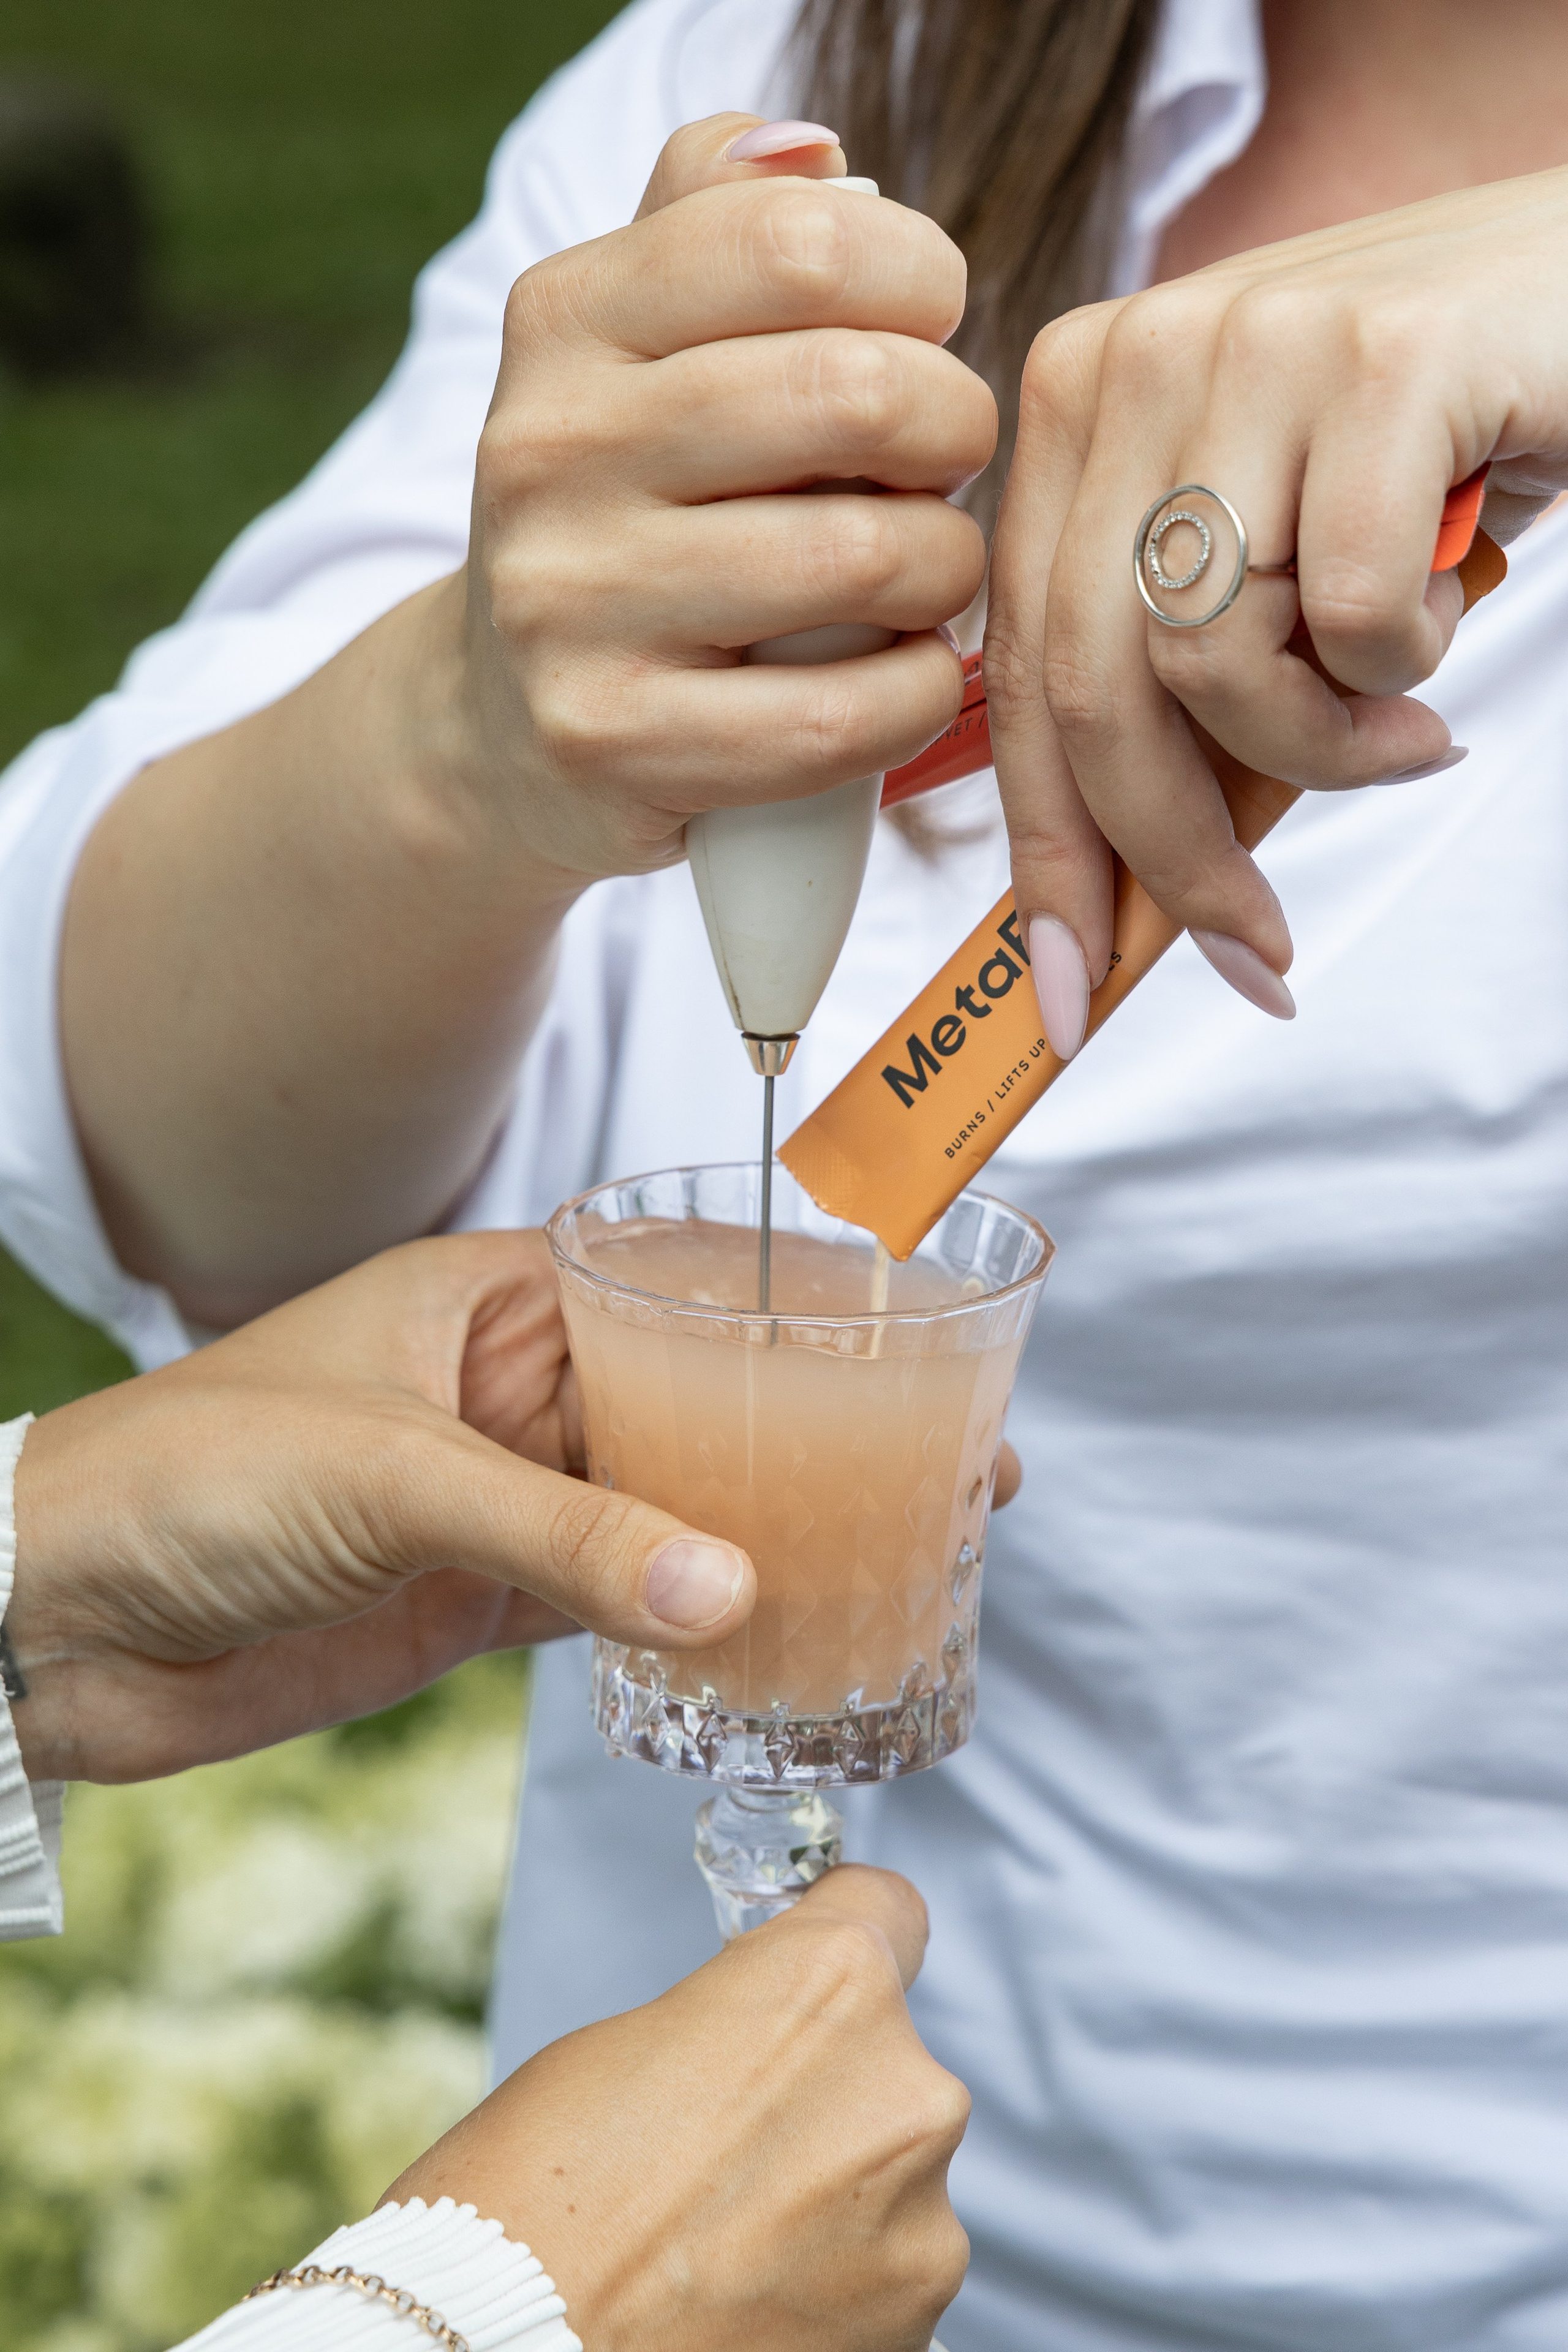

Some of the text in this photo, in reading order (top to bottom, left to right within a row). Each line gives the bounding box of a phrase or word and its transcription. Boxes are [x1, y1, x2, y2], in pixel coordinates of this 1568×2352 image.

[944, 1038, 1047, 1159] BURNS / LIFTS UP
